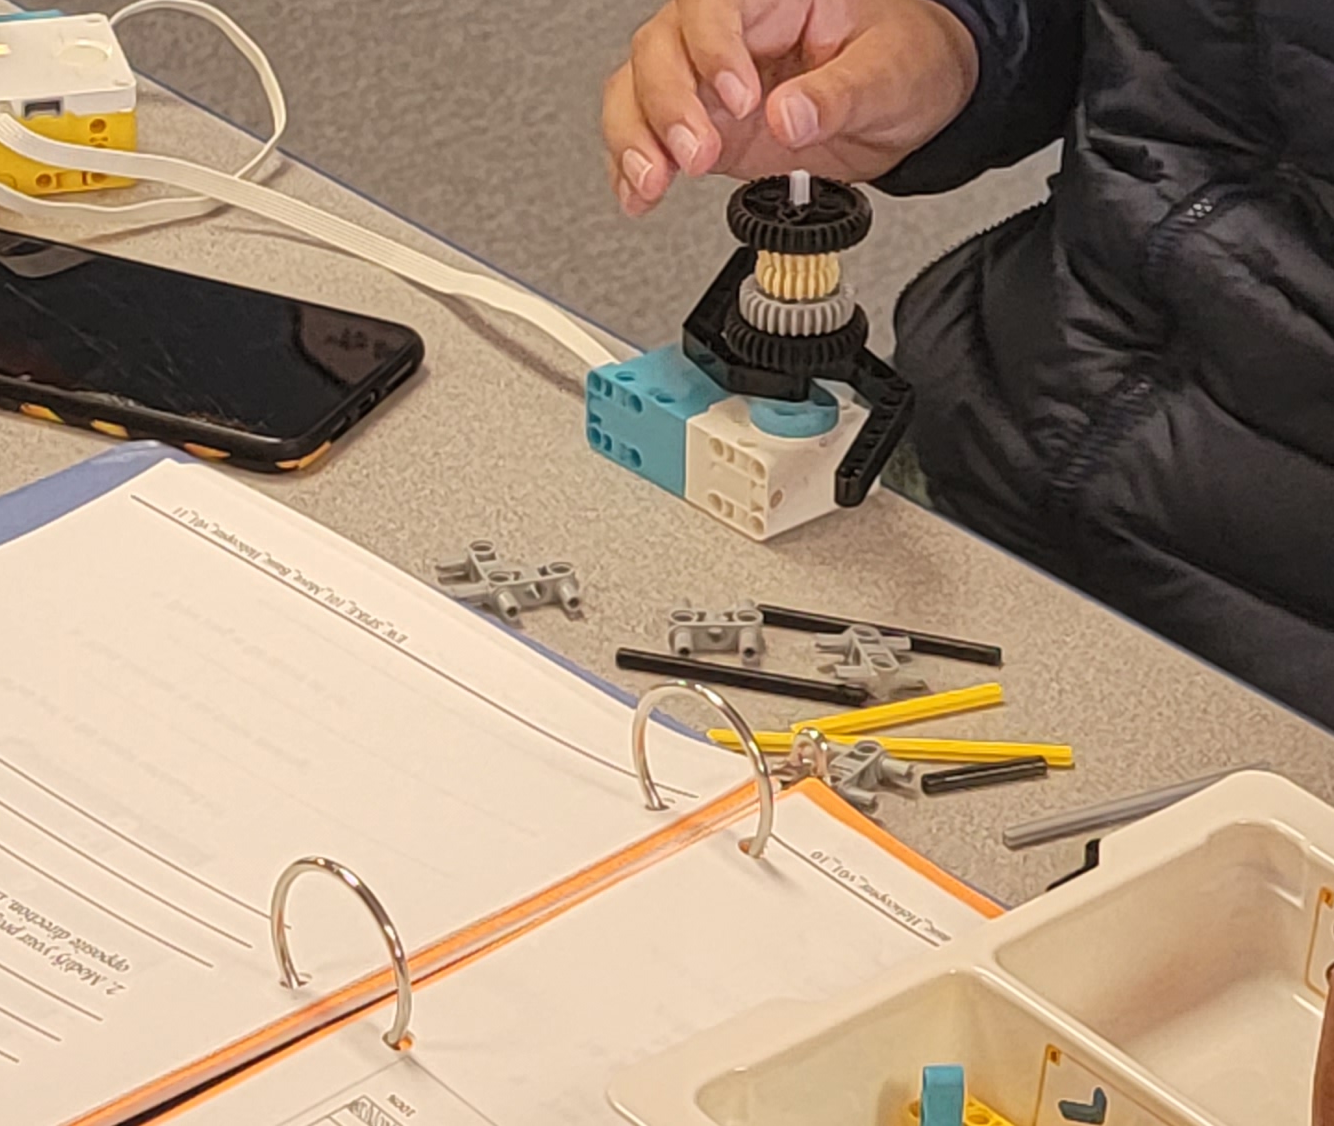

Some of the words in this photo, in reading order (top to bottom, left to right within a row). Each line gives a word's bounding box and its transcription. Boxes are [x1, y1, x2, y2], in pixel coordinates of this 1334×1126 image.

[16, 933, 60, 956] your
[68, 938, 129, 972] opposite
[49, 953, 108, 986] Modify
